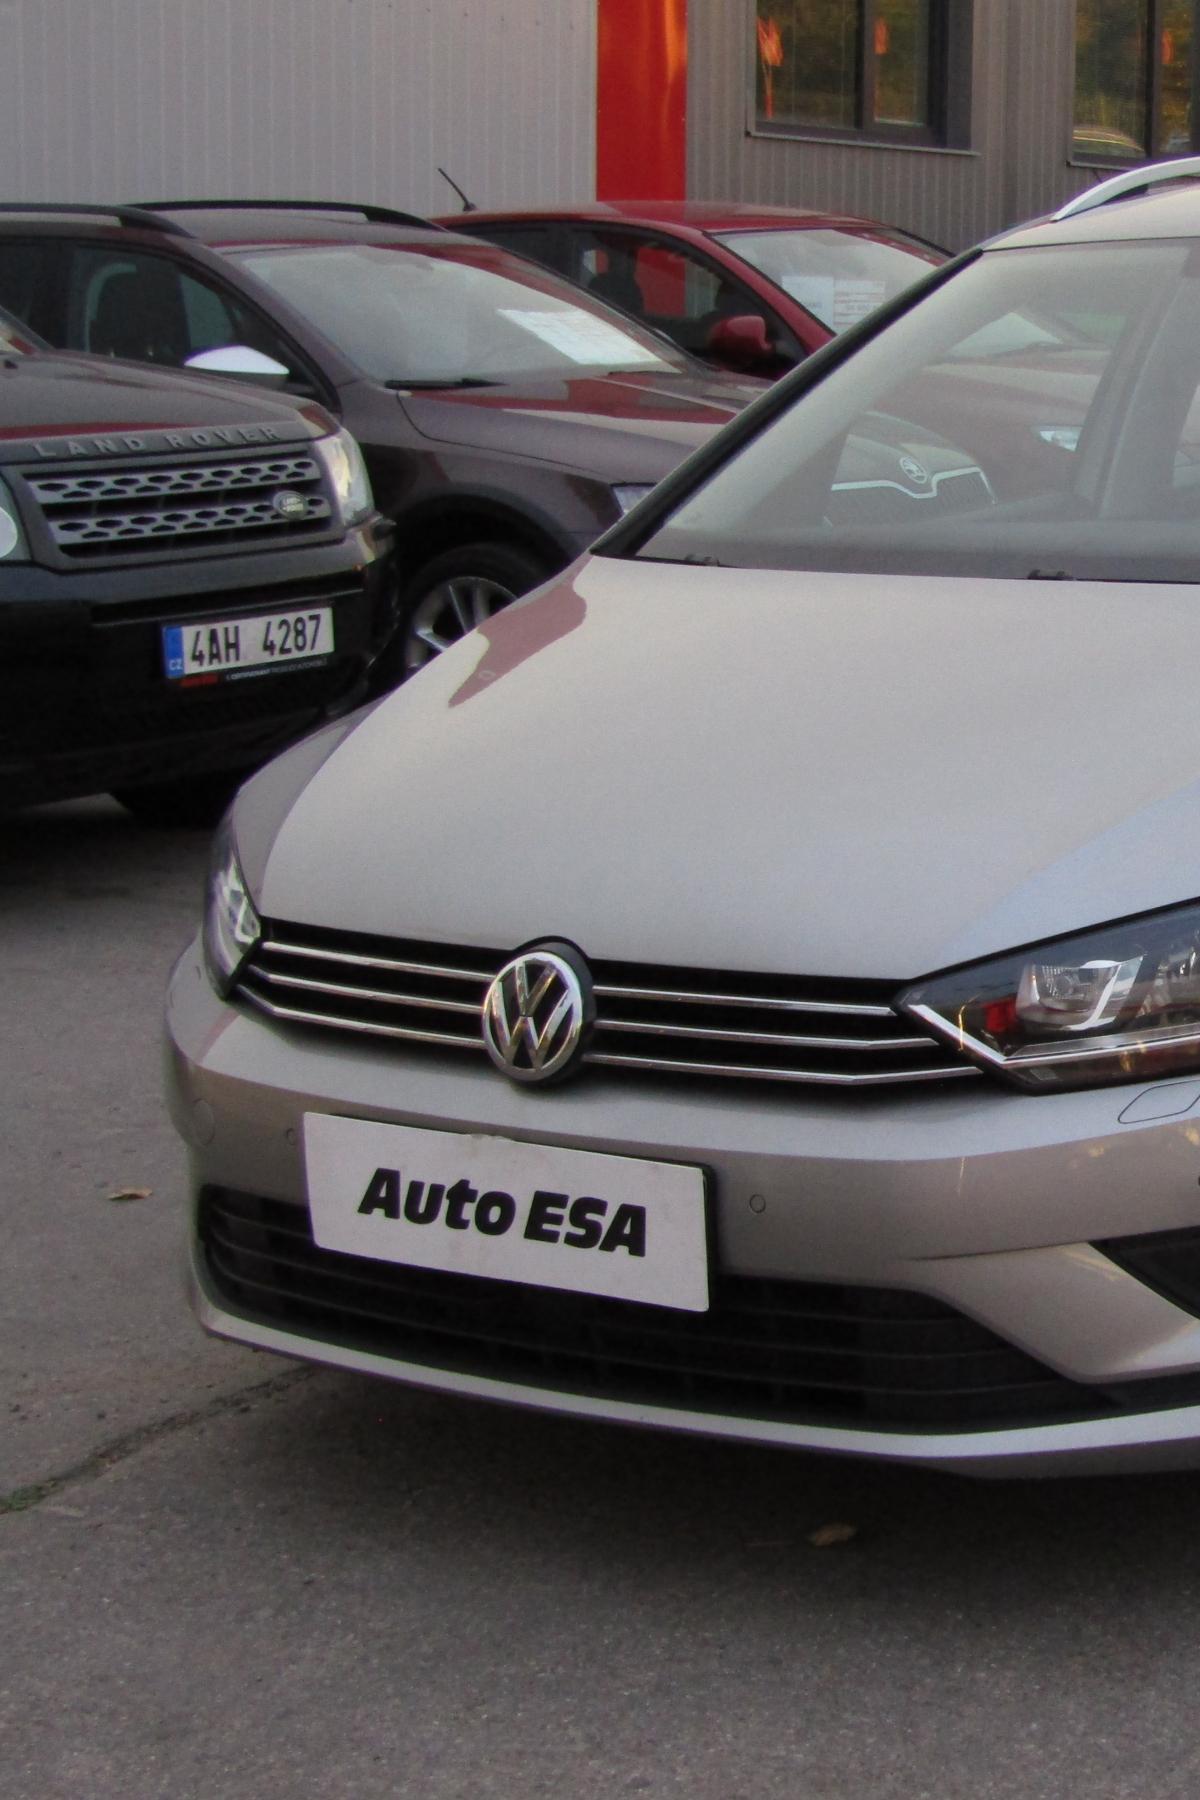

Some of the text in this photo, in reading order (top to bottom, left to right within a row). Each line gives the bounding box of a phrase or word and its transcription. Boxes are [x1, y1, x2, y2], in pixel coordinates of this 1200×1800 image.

[34, 427, 281, 457] LAND ROVER
[190, 613, 321, 667] 4AH 4287
[357, 1167, 647, 1258] Auto ESA
